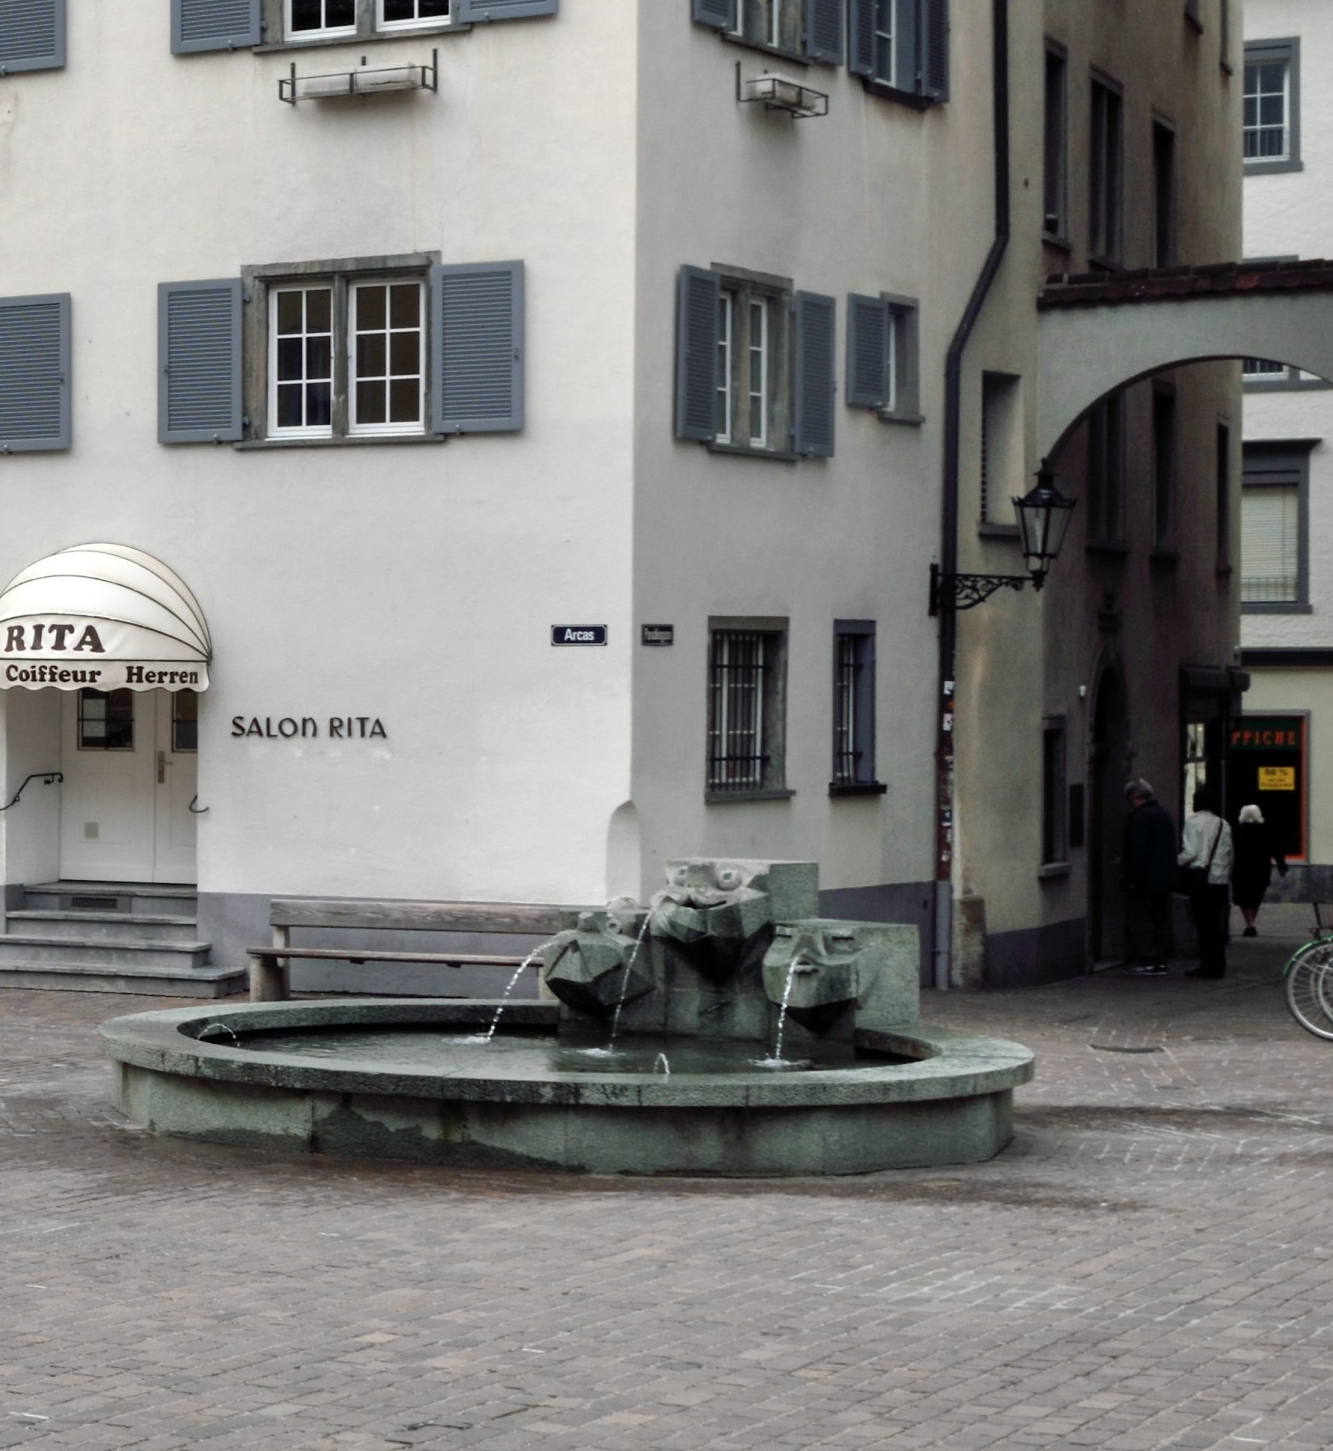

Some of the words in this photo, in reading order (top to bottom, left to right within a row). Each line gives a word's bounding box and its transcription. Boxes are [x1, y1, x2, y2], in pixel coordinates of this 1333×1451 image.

[4, 623, 106, 654] RITA
[564, 628, 595, 641] Arcas
[5, 664, 102, 684] Coiffeur
[125, 665, 199, 685] Herren
[231, 715, 318, 739] SALON
[329, 716, 388, 739] RITA
